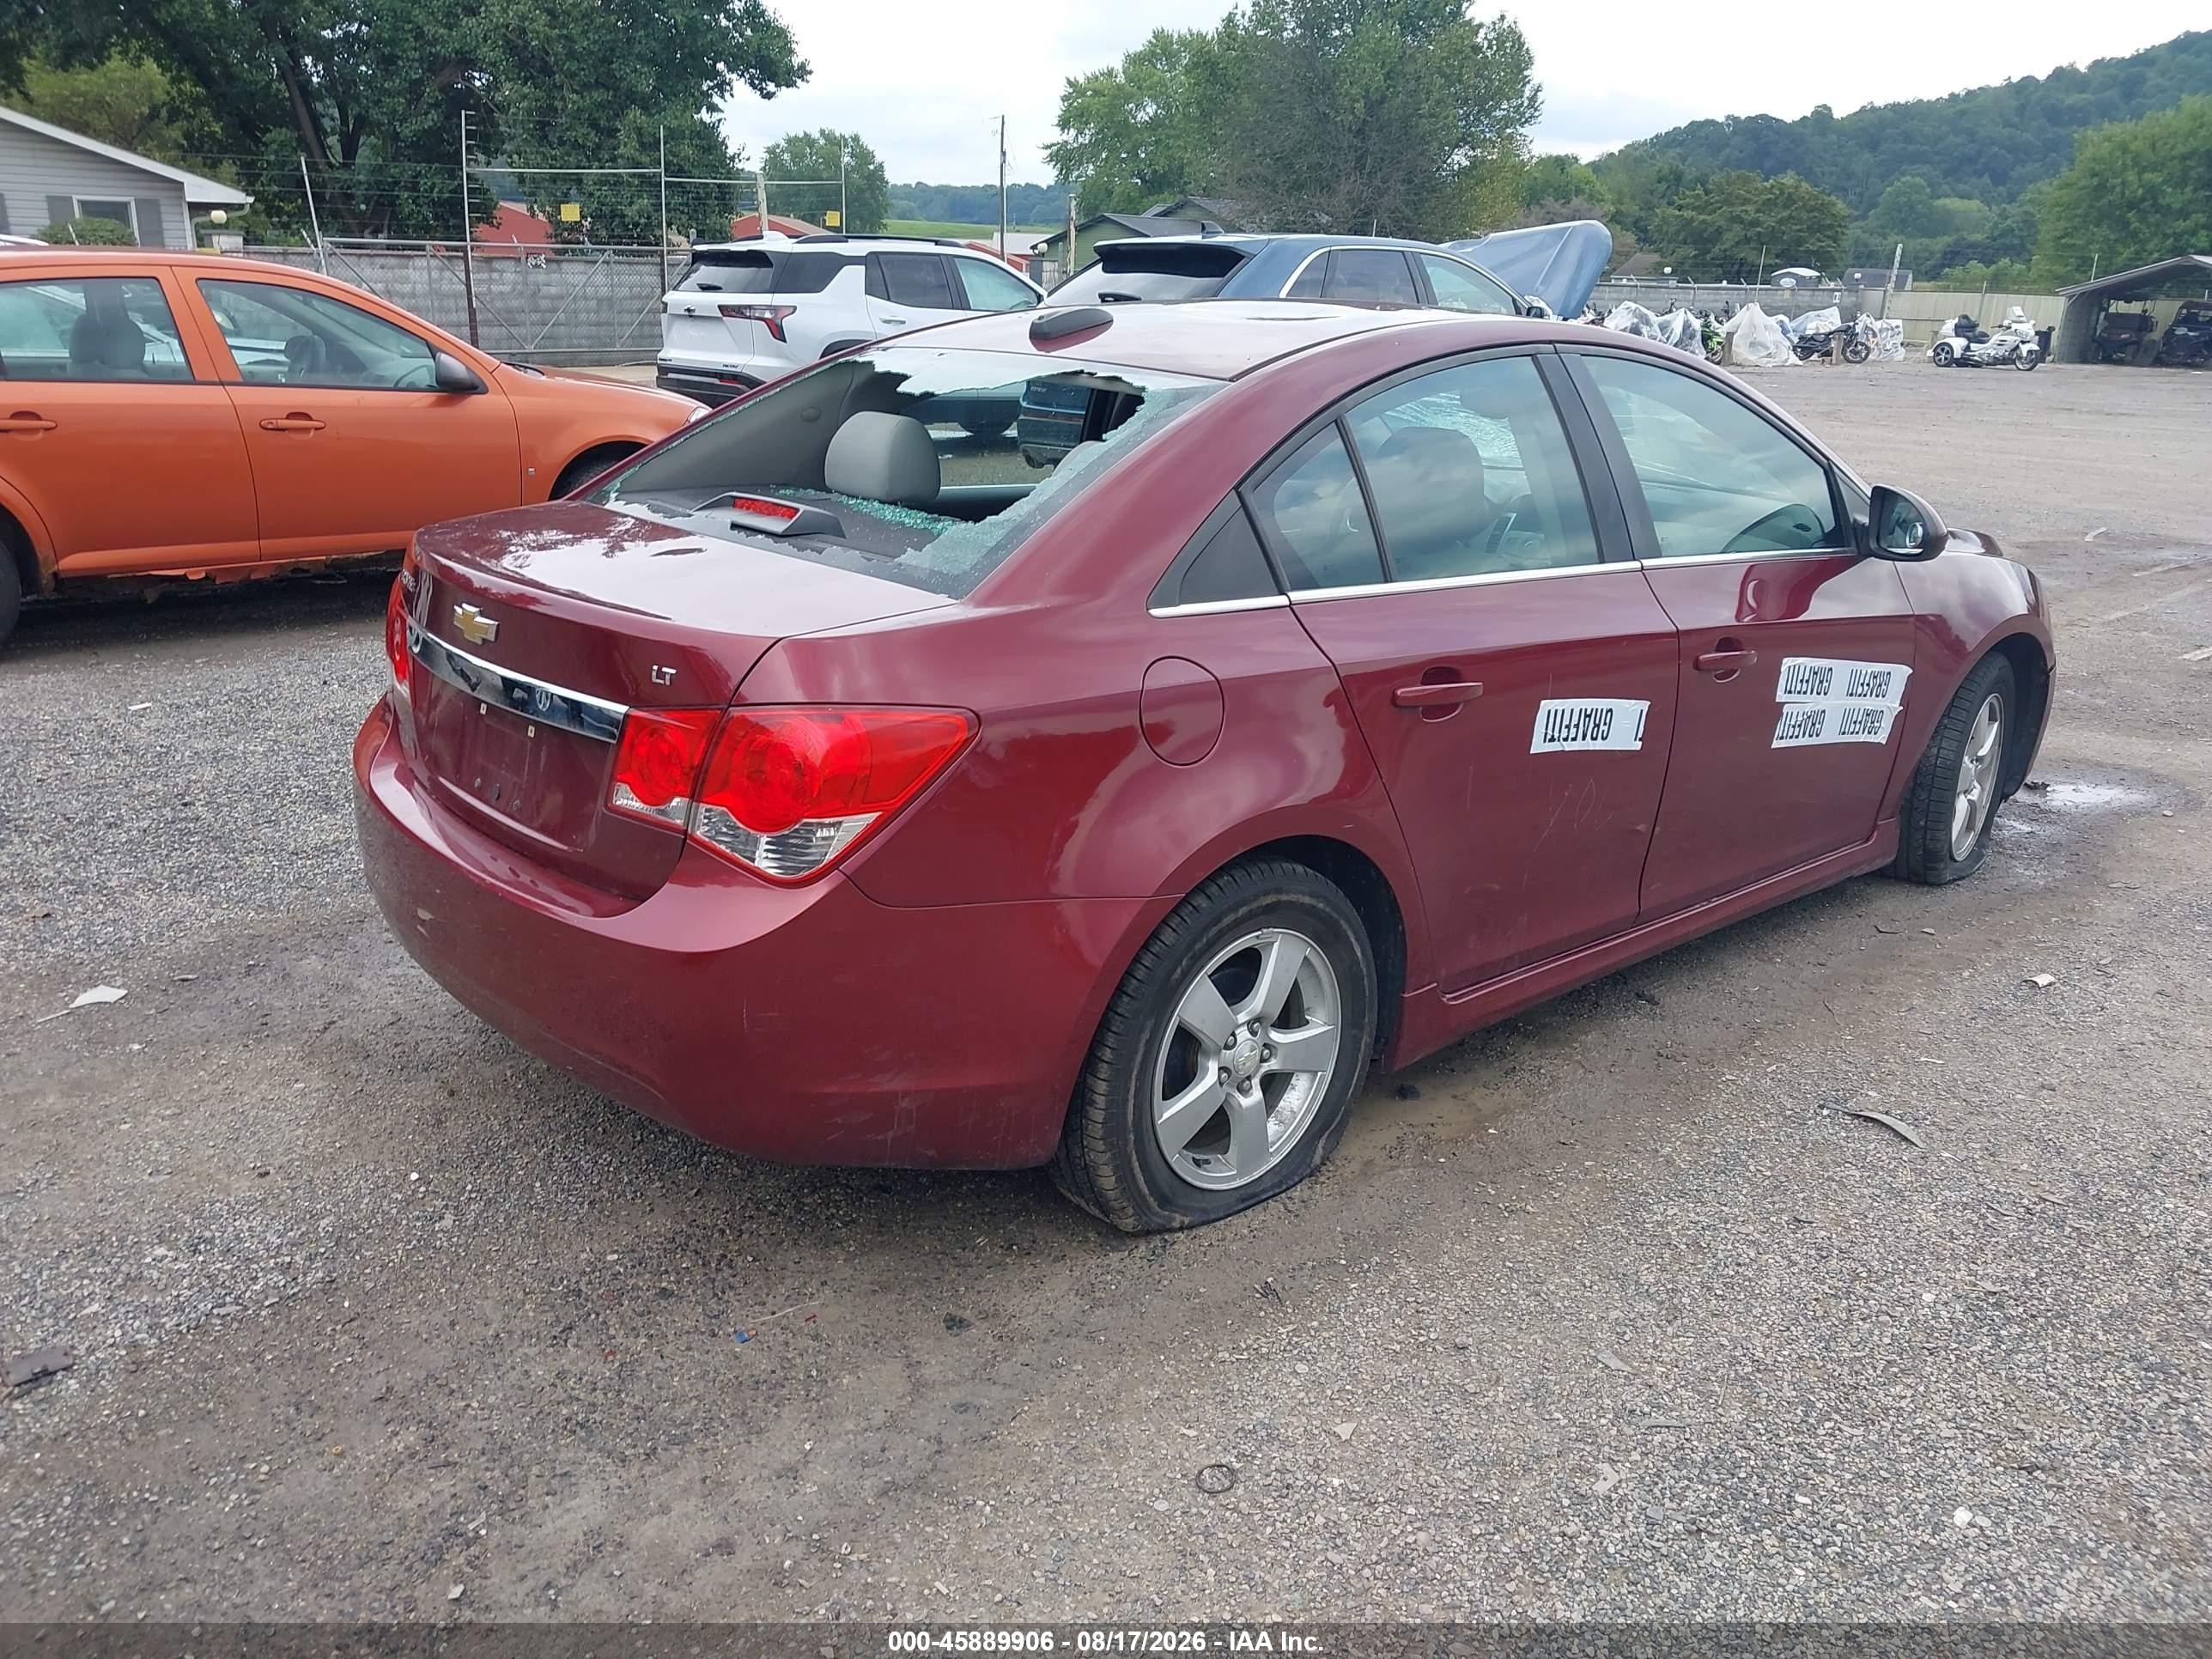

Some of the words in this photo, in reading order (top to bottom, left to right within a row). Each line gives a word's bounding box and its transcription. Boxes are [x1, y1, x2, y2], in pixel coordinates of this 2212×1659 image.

[652, 665, 678, 686] LT
[1784, 665, 1833, 696] GRAFFITI
[1845, 669, 1892, 699] GRAFFITI
[1543, 708, 1613, 744] GRAFFITI
[1775, 708, 1826, 741] GRAFFITI
[1838, 708, 1885, 736] GRAFFITI
